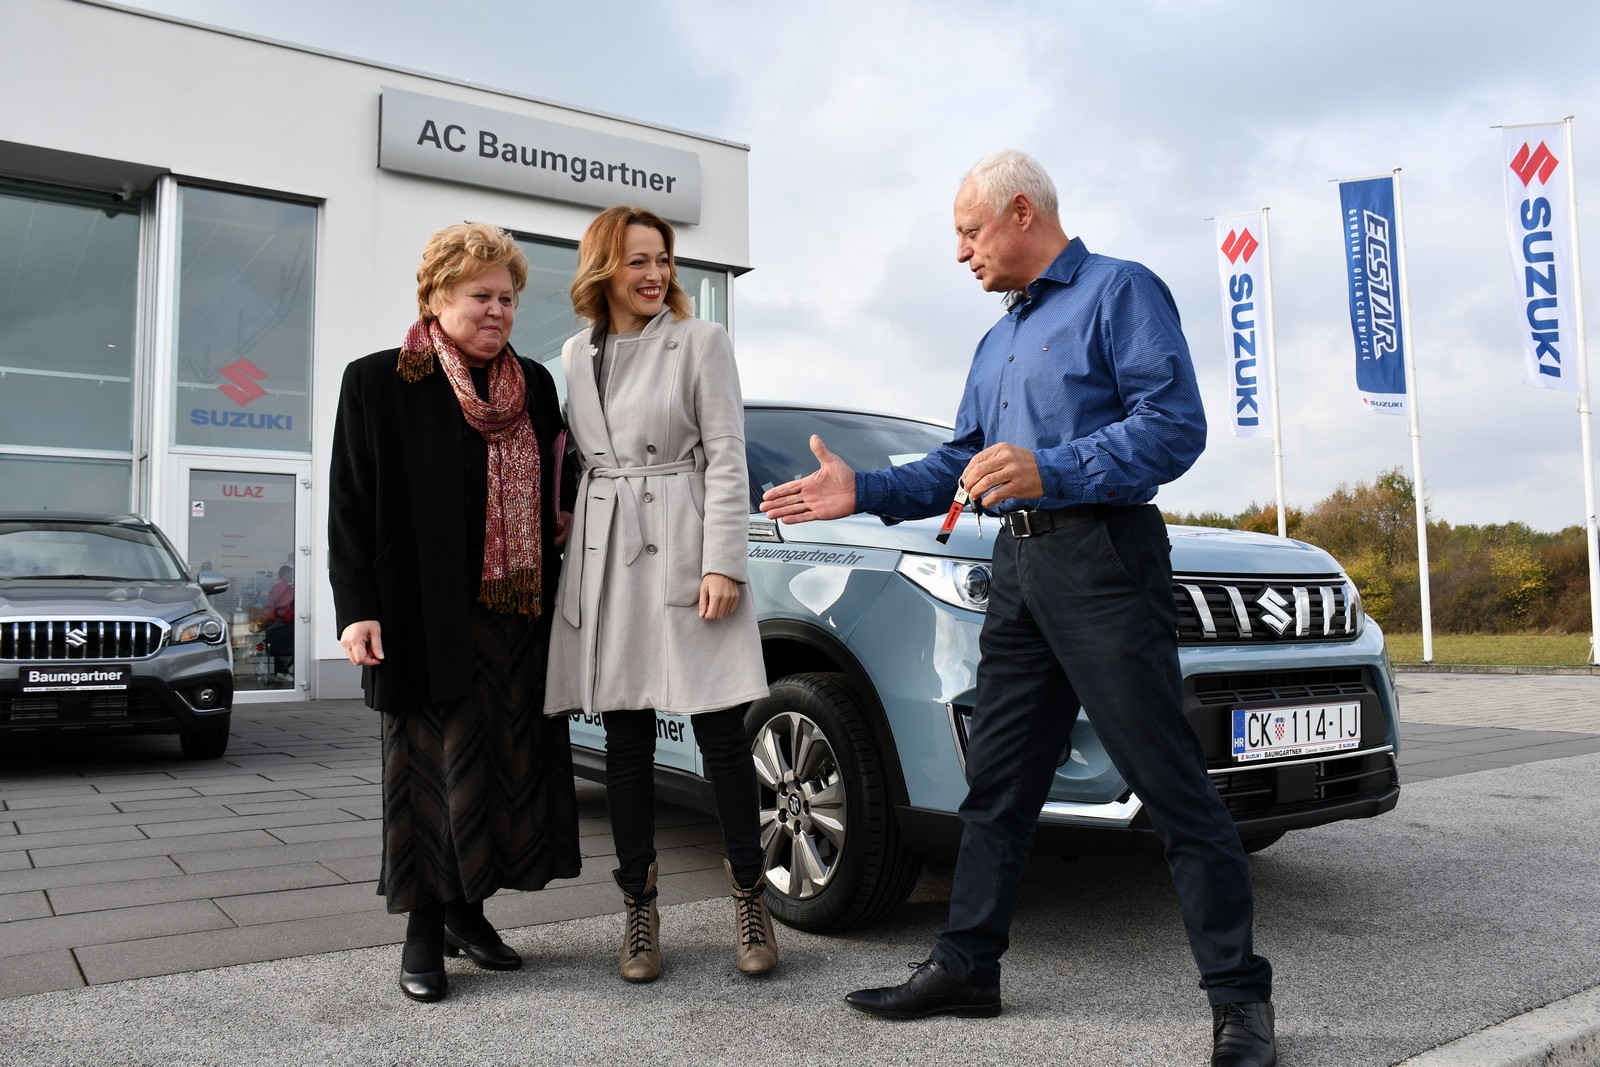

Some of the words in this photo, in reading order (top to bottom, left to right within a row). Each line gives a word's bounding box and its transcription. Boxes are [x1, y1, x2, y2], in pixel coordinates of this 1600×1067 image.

[416, 119, 466, 153] AC
[478, 129, 677, 194] Baumgartner
[1348, 209, 1361, 260] GENUINE
[1362, 208, 1398, 361] ECSTAR
[1520, 196, 1562, 378] SUZUKI
[1229, 273, 1259, 427] SUZUKI
[1370, 400, 1403, 408] SUZUKI
[190, 408, 292, 431] SUZUKI
[222, 484, 264, 499] ULAZ
[28, 670, 123, 684] Baumgartner
[1234, 737, 1245, 748] HR
[1248, 712, 1273, 748] ČK
[1264, 748, 1302, 758] BAUMGARTNER
